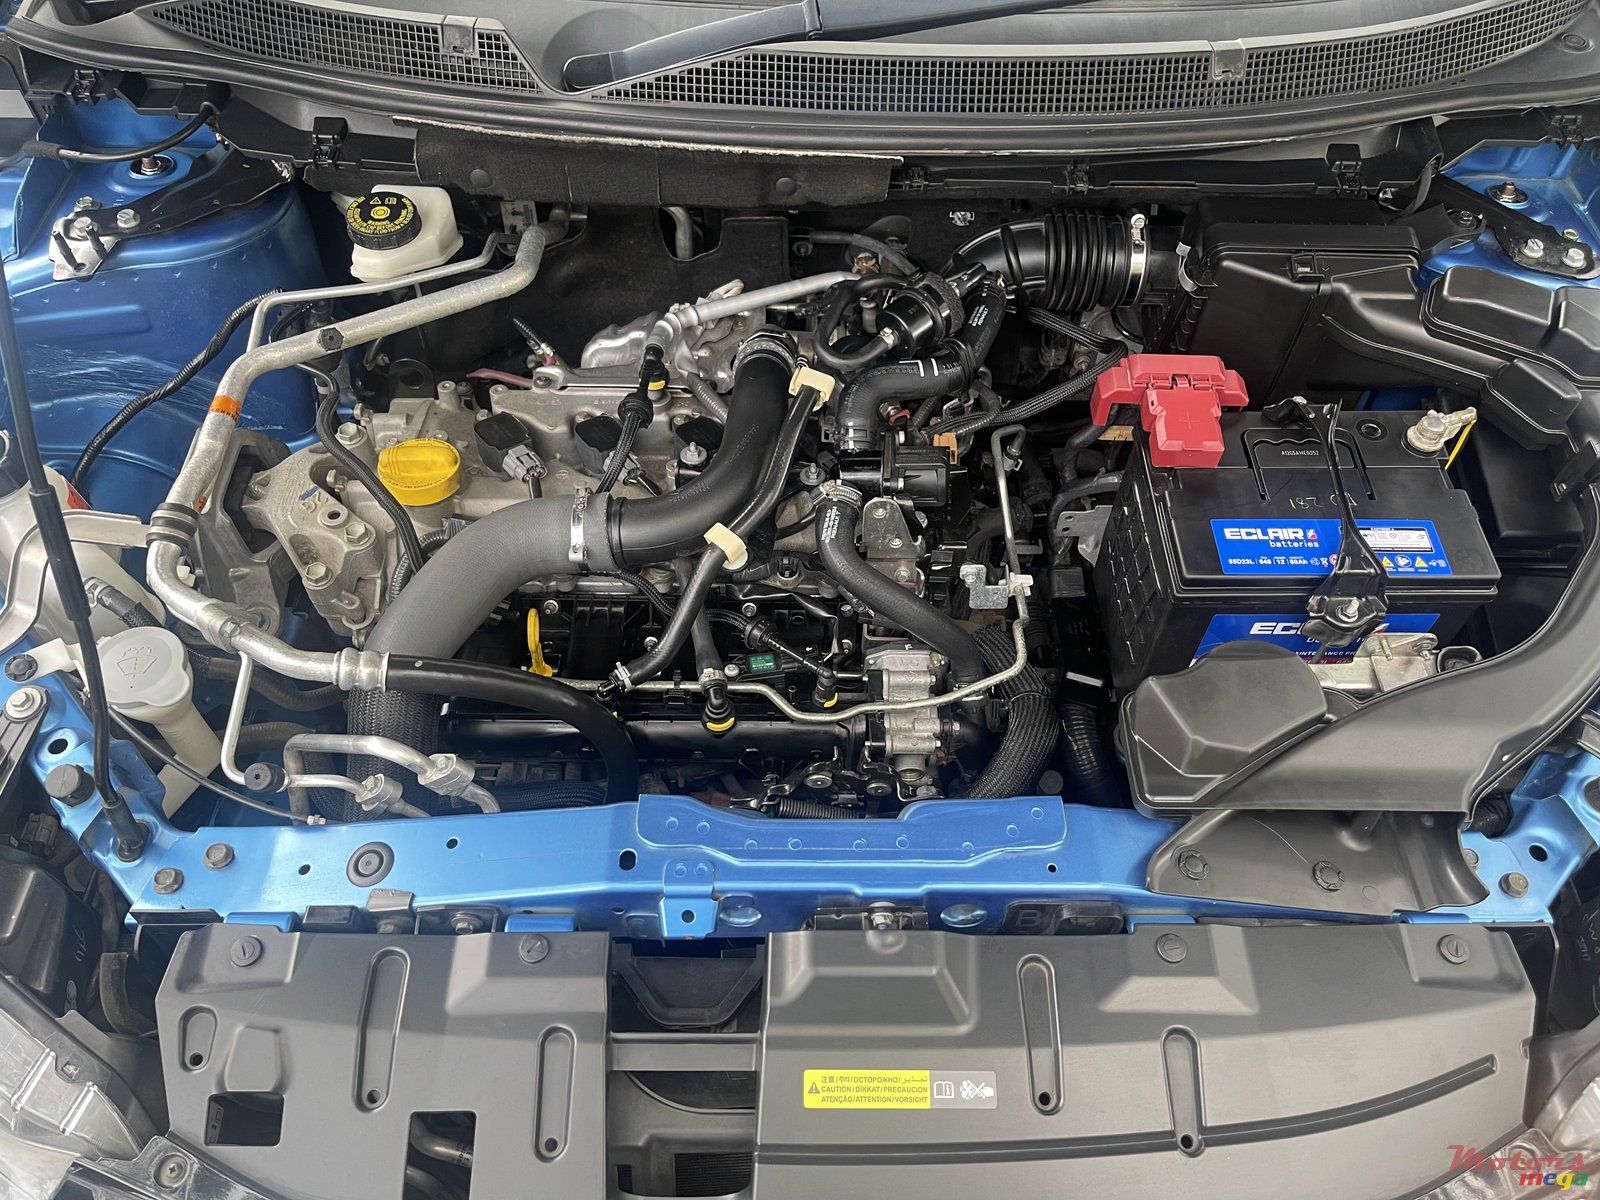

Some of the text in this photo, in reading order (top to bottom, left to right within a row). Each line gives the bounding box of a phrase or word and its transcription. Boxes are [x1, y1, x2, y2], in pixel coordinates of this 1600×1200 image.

[1223, 528, 1305, 540] ECLAIR
[1269, 540, 1319, 548] batteries
[821, 1095, 854, 1104] ATENÇÃO
